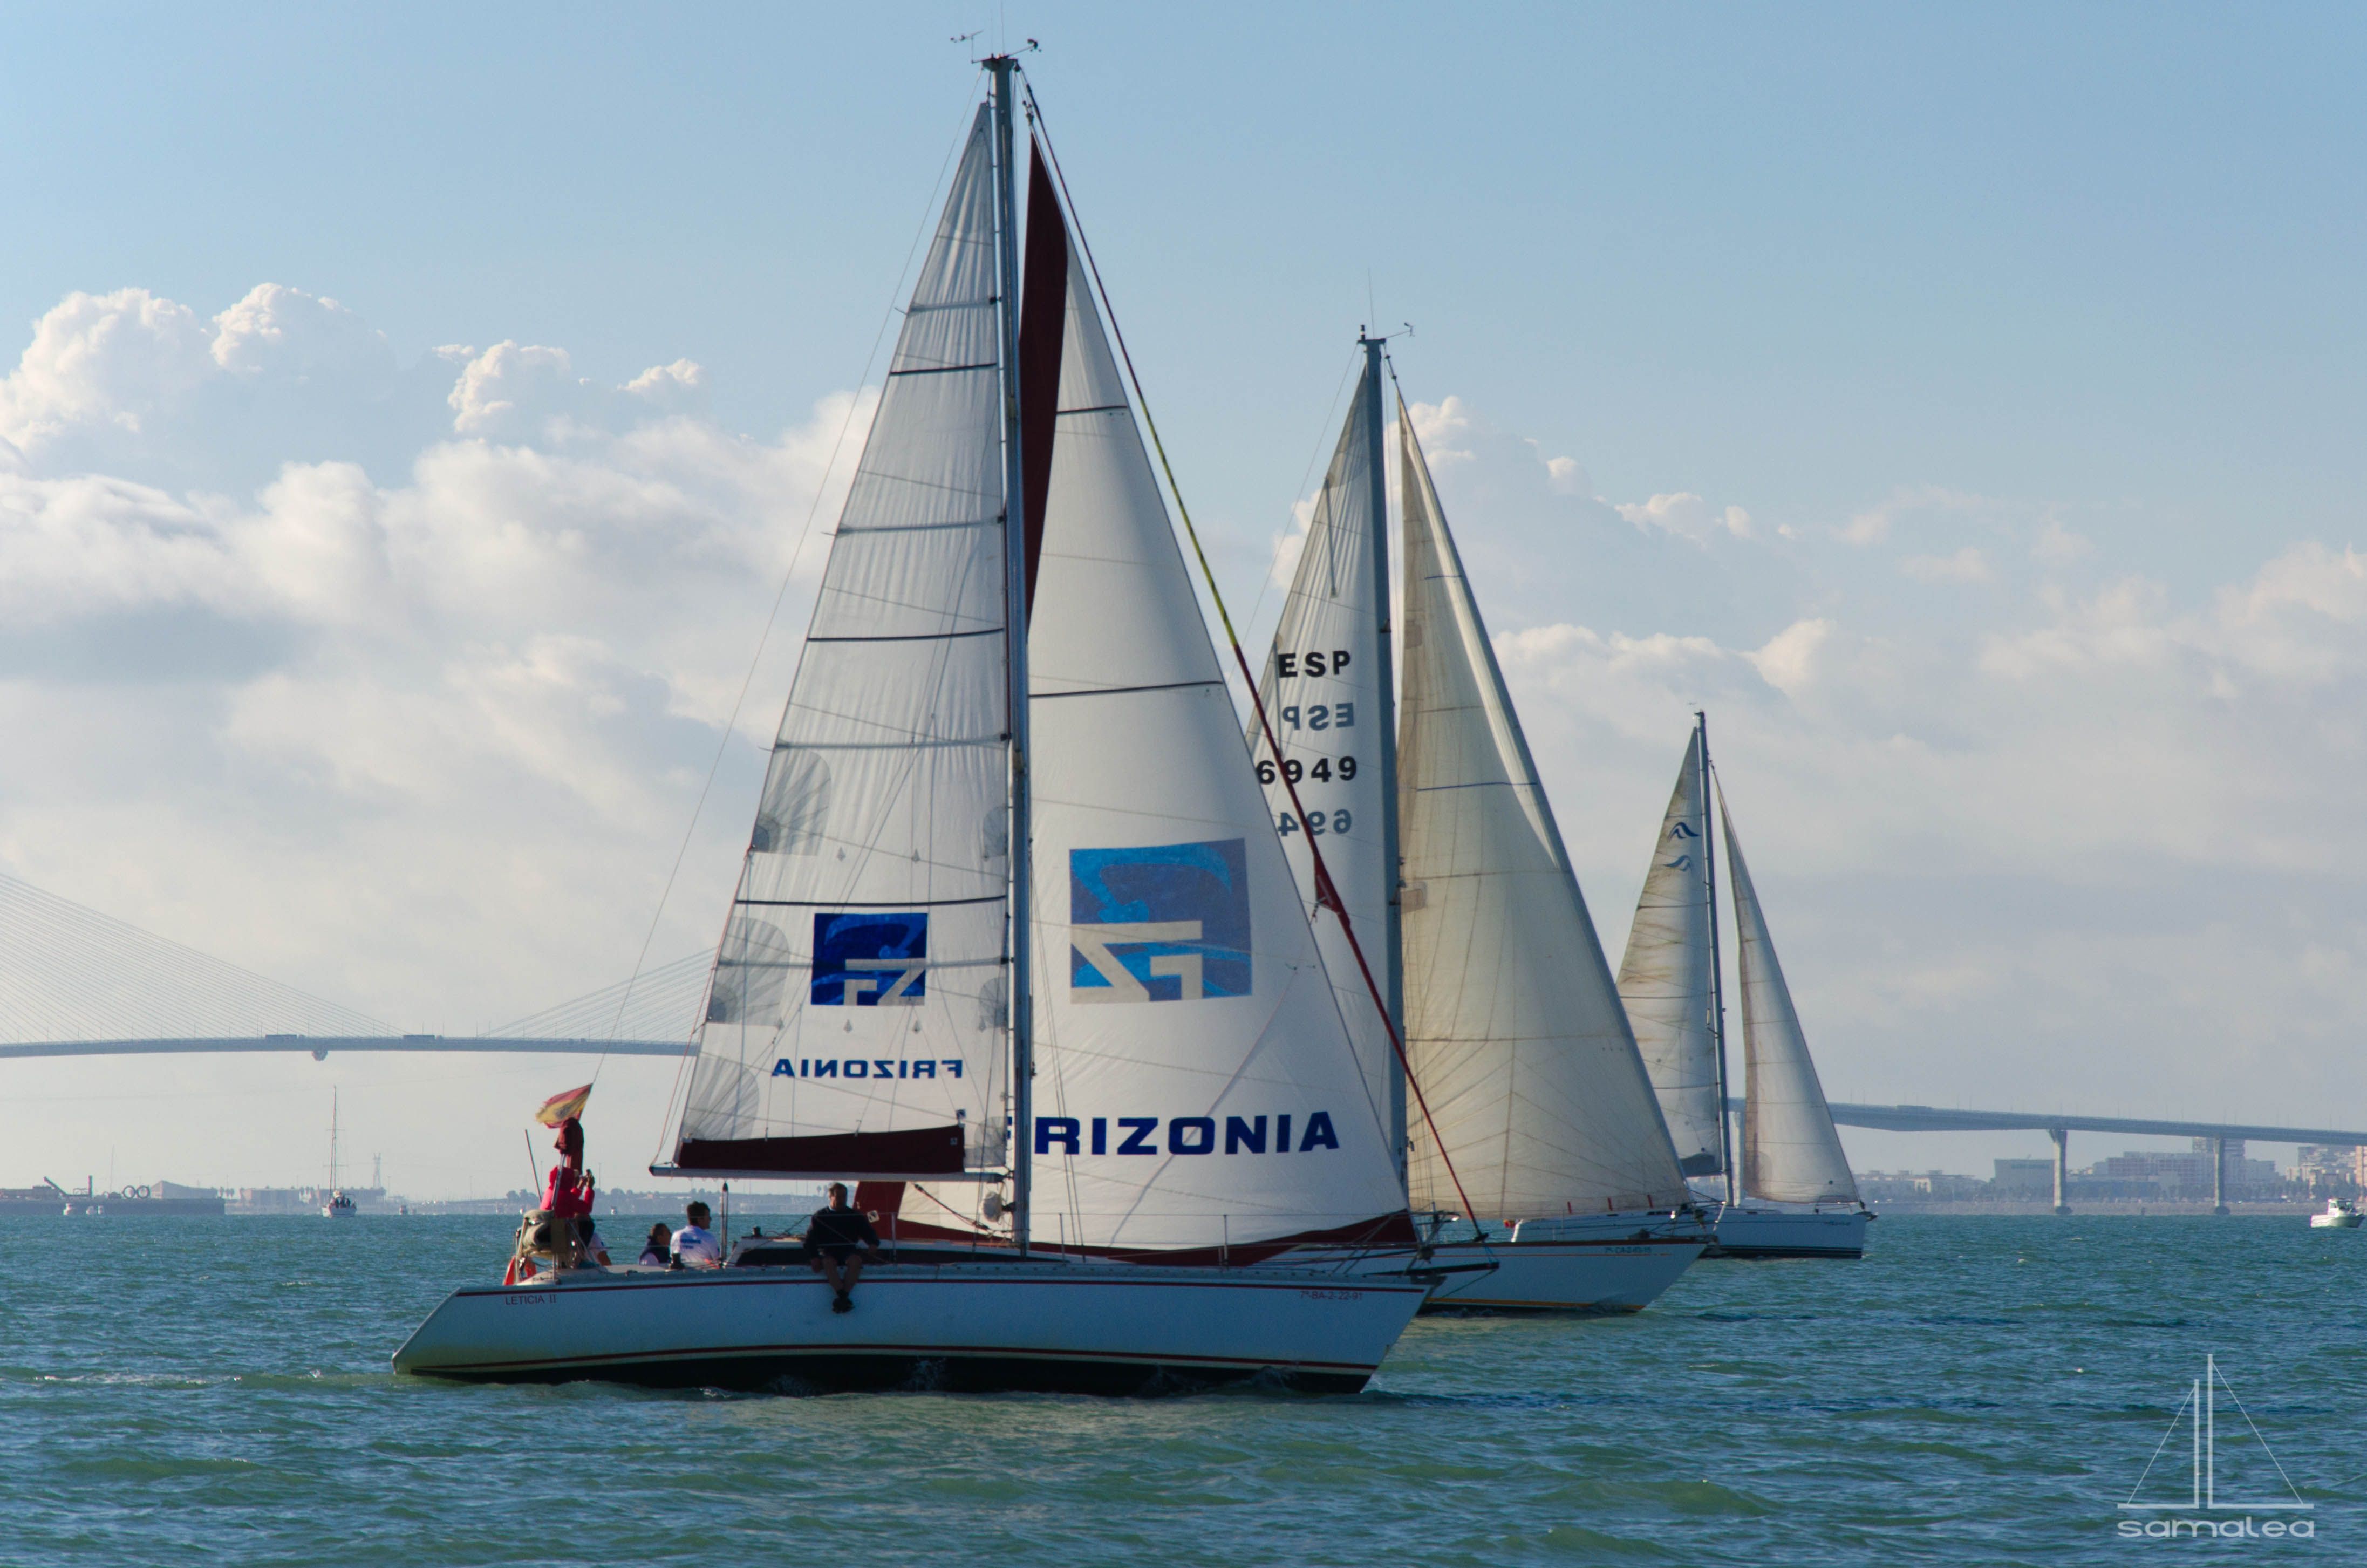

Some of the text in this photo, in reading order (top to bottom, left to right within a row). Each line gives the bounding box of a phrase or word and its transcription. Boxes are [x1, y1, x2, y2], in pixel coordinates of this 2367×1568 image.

[1277, 651, 1351, 678] ESP
[1256, 756, 1356, 785] 6949
[1007, 1111, 1340, 1155] RIZONIA
[505, 1294, 556, 1305] LETICIA II
